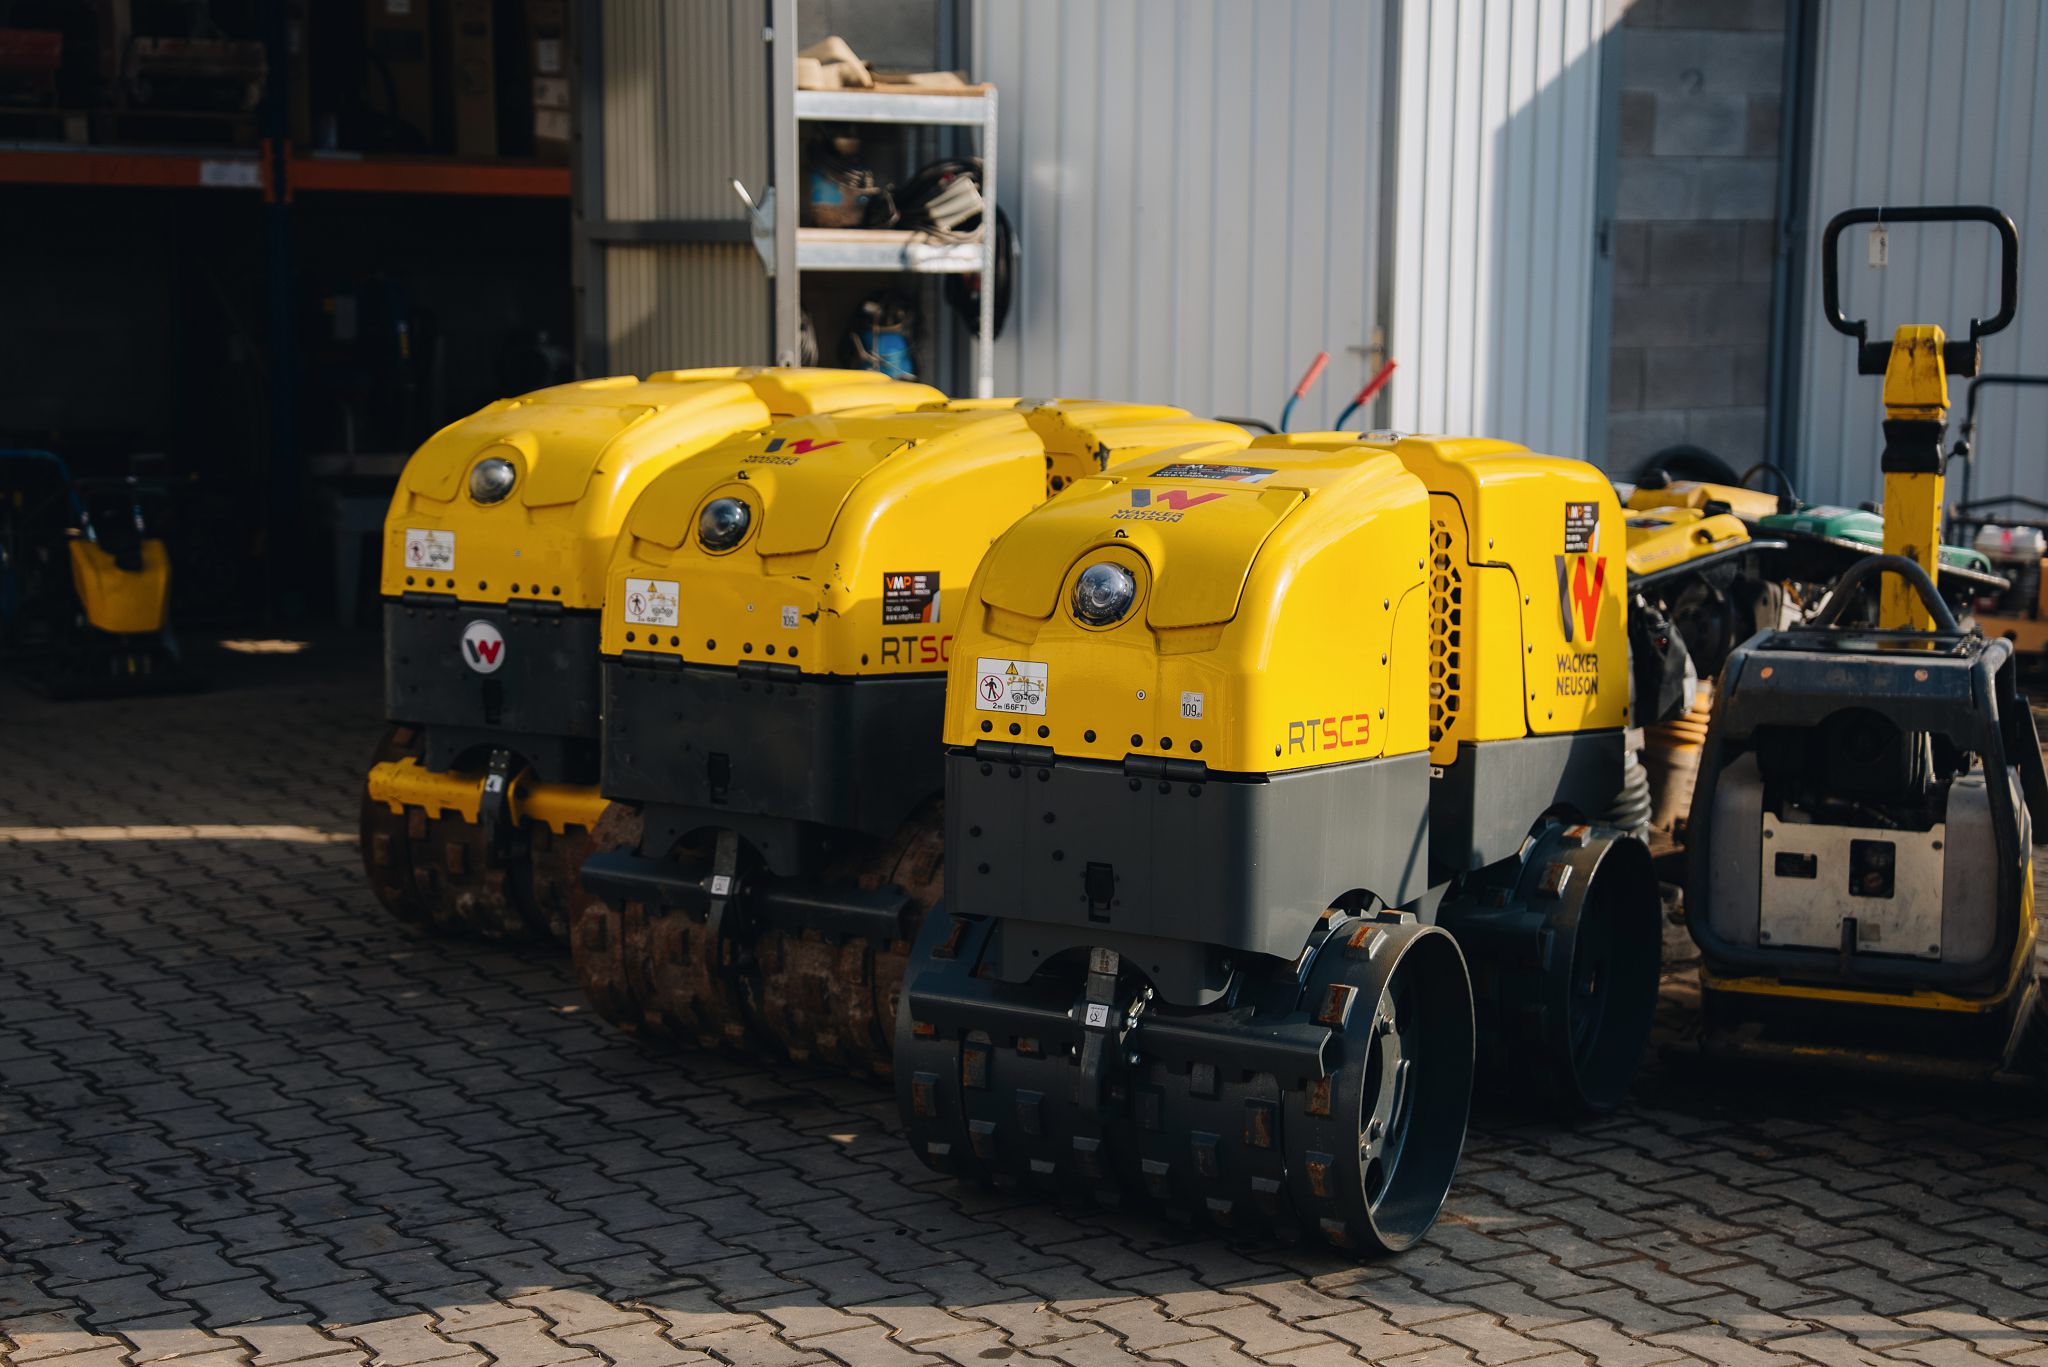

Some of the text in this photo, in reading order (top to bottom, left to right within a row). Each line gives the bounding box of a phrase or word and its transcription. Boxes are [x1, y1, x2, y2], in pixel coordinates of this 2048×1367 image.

[1110, 513, 1182, 523] NEUSON
[1117, 509, 1184, 518] WACKER
[886, 576, 912, 590] VMP
[881, 635, 953, 665] RTSC
[1556, 654, 1599, 673] WACKER
[1556, 676, 1599, 696] NEUSON
[1182, 703, 1197, 717] 109
[1289, 713, 1370, 755] RTSC3
